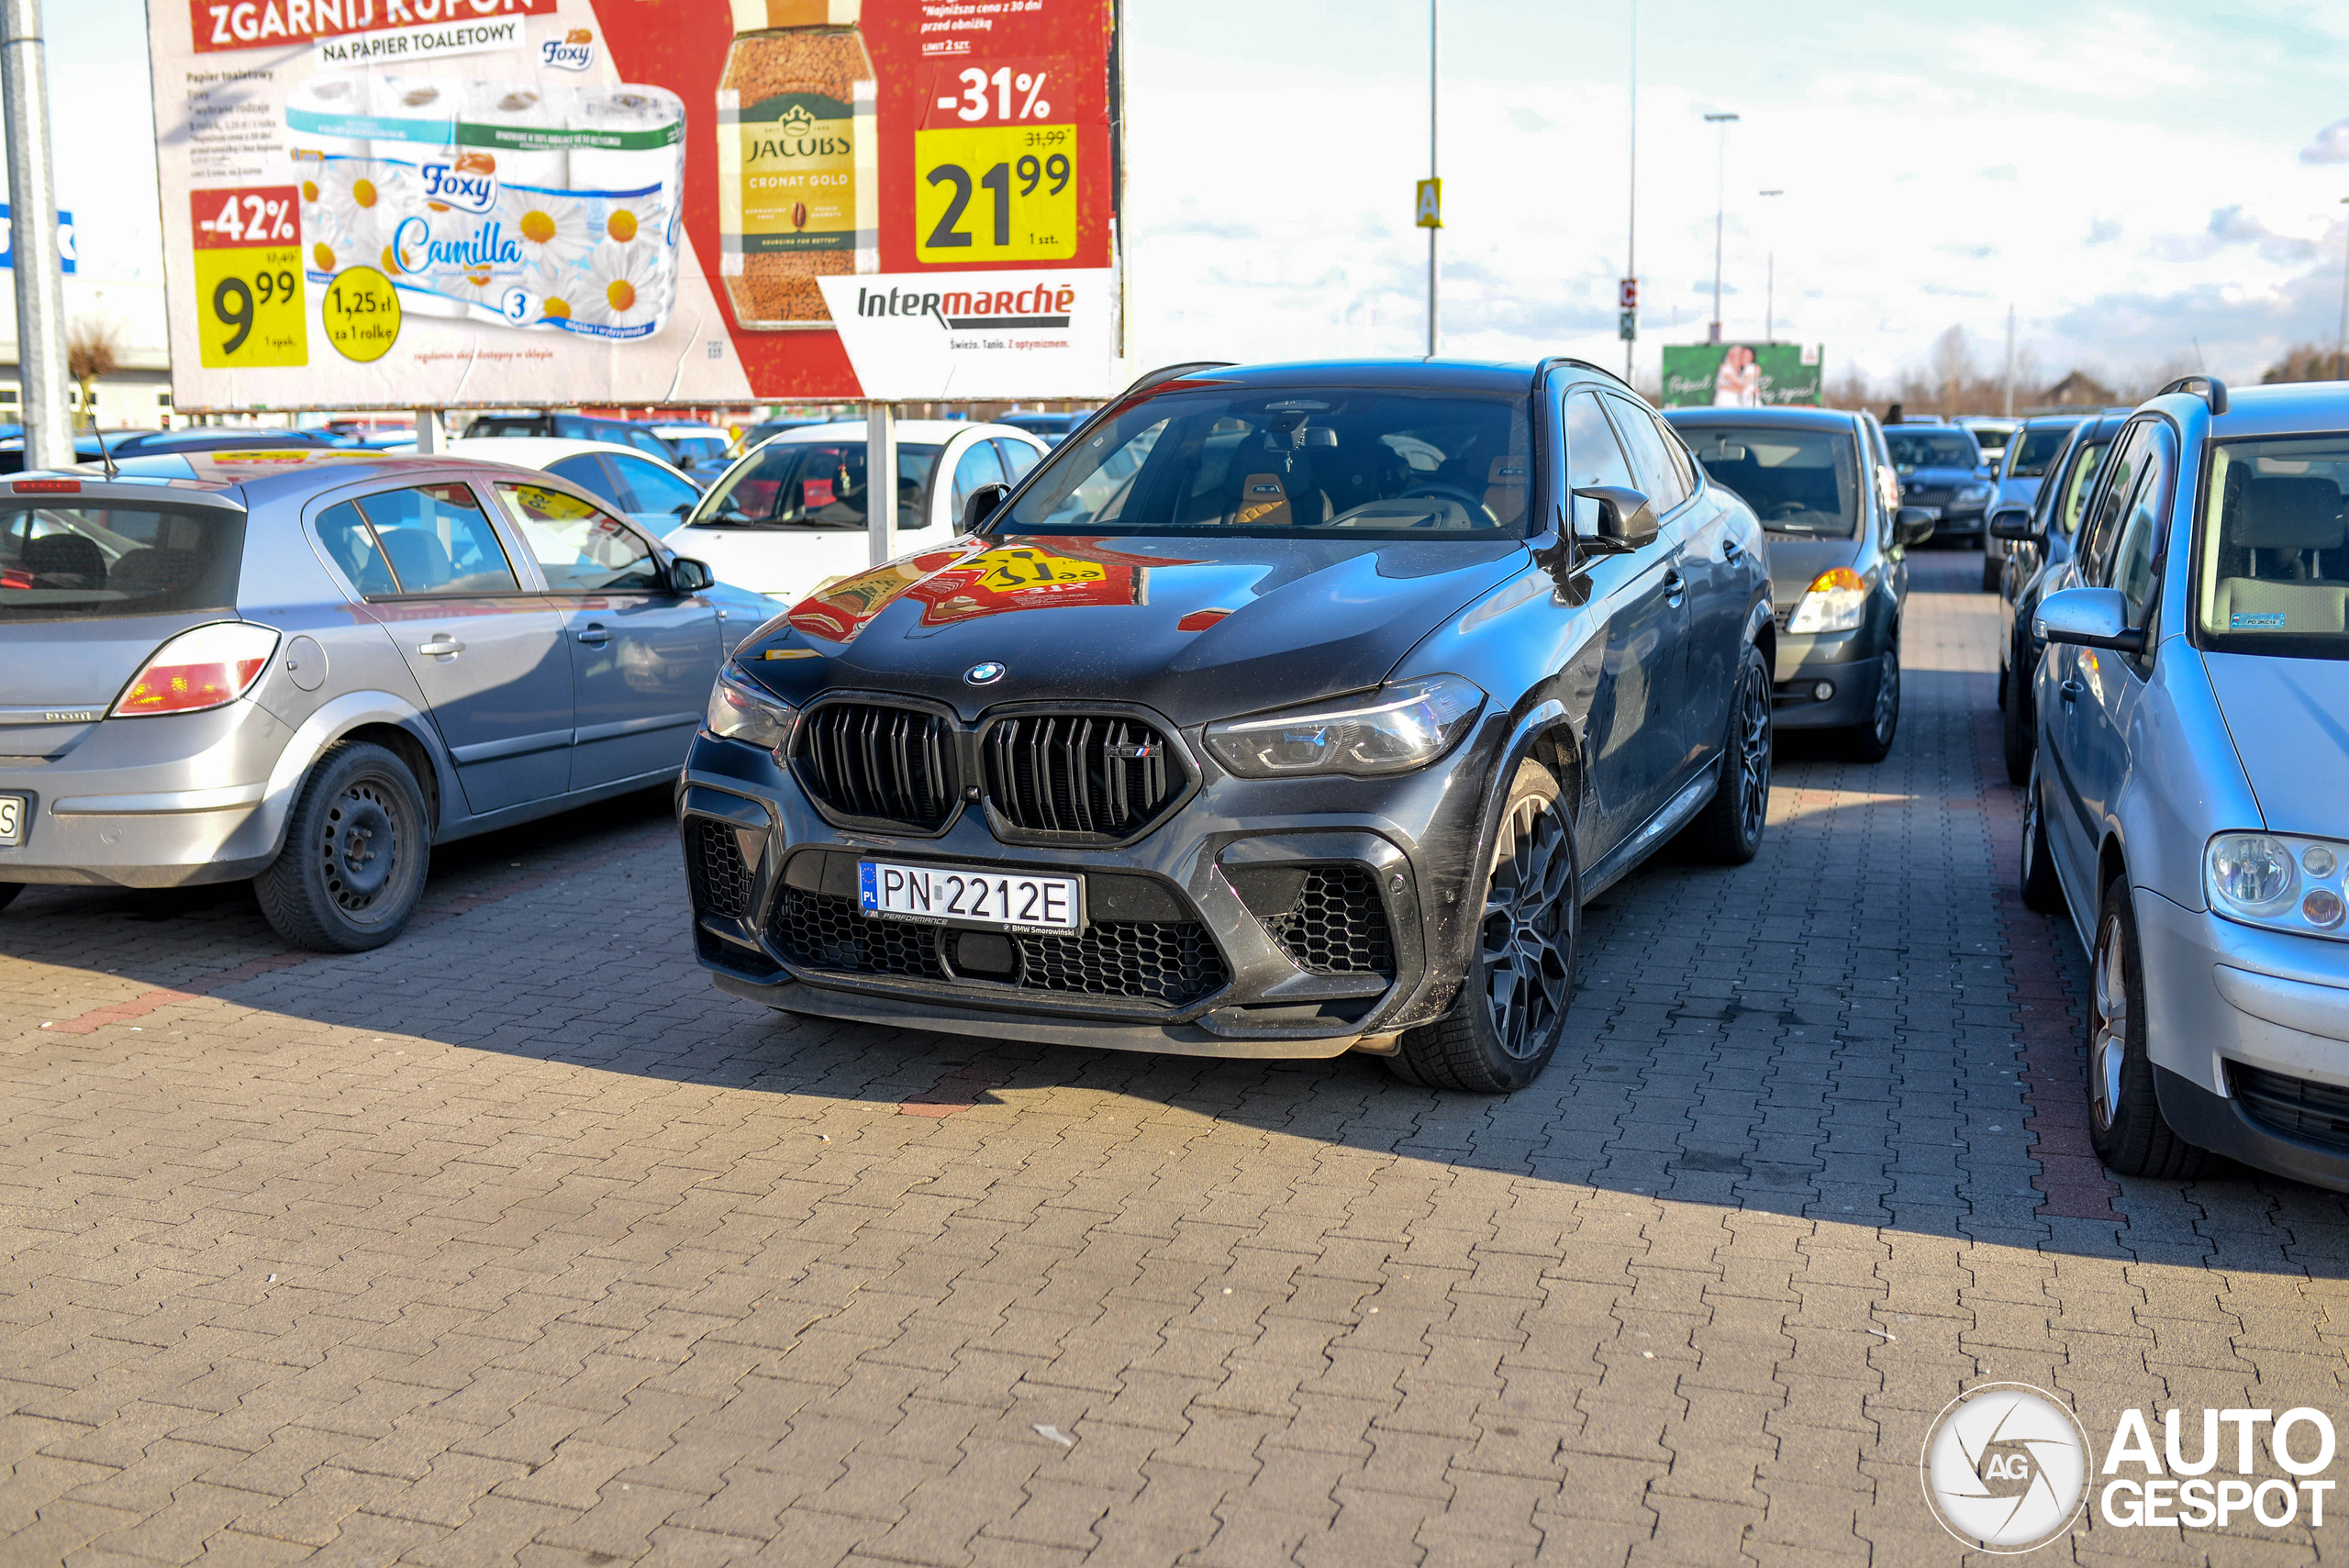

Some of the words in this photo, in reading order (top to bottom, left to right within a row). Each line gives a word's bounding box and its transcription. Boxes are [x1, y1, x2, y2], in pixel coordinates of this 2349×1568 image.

[975, 5, 1001, 14] cena
[1002, 3, 1009, 12] z
[1010, 1, 1024, 12] 30
[1024, 0, 1043, 11] dni
[209, 0, 373, 44] ZGARNIJ
[920, 19, 951, 34] przed
[951, 17, 992, 31] obniżką
[323, 45, 348, 62] NA
[351, 34, 408, 59] PAPIER
[412, 23, 516, 51] TOALETOWY
[542, 39, 590, 66] Foxy
[945, 39, 953, 50] 2
[937, 66, 1051, 121] -31%
[423, 164, 493, 206] Foxy
[749, 176, 805, 188] CRONAT
[809, 174, 848, 186] GOLD
[926, 163, 1009, 248] 21
[1017, 153, 1070, 197] 99
[1419, 183, 1440, 222] A
[200, 195, 295, 241] -42%
[393, 217, 522, 274] Camilla
[1039, 234, 1059, 245] szt.
[334, 287, 376, 320] 1,25
[511, 294, 527, 317] 3
[1621, 282, 1635, 305] C
[214, 277, 254, 355] 9
[256, 272, 295, 304] 99
[336, 328, 347, 340] za
[351, 327, 356, 339] 1
[361, 325, 392, 343] rolkę
[1008, 339, 1013, 348] Z
[1016, 338, 1070, 350] optymizmem.
[863, 891, 876, 903] PL
[884, 869, 930, 911] PN
[946, 875, 1066, 923] 2212E
[883, 912, 949, 926] PERFORMANCE
[1011, 925, 1030, 933] BMW
